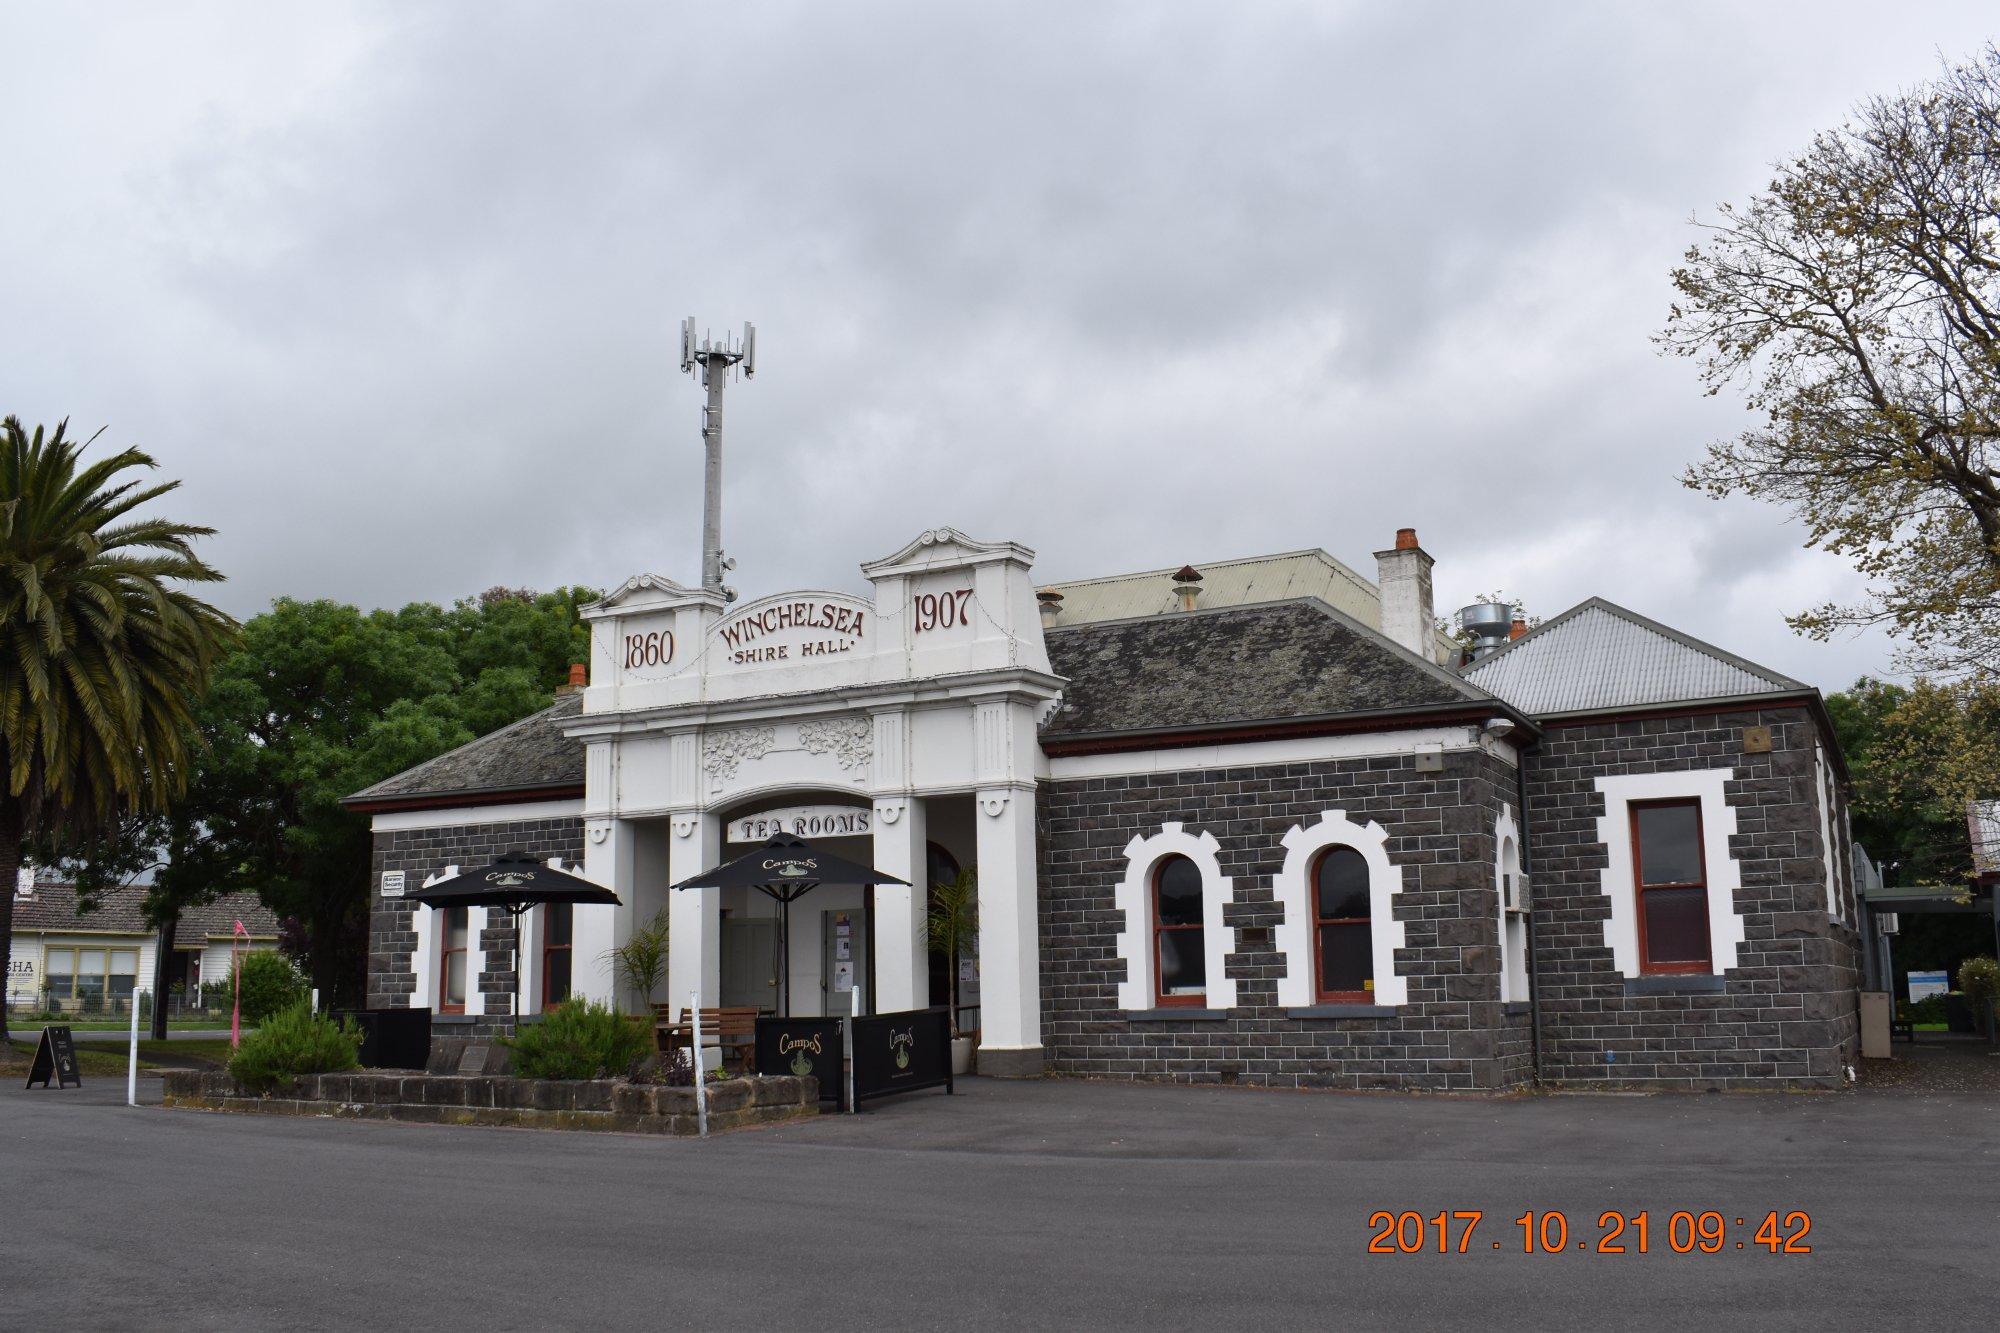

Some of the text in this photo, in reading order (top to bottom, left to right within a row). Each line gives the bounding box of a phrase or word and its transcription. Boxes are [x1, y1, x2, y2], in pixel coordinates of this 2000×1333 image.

[720, 602, 864, 650] WINCHELSEA
[914, 588, 974, 634] 1907
[625, 630, 674, 669] 1860
[734, 638, 849, 664] SHIRE HALL
[741, 811, 869, 840] TEA ROOMS
